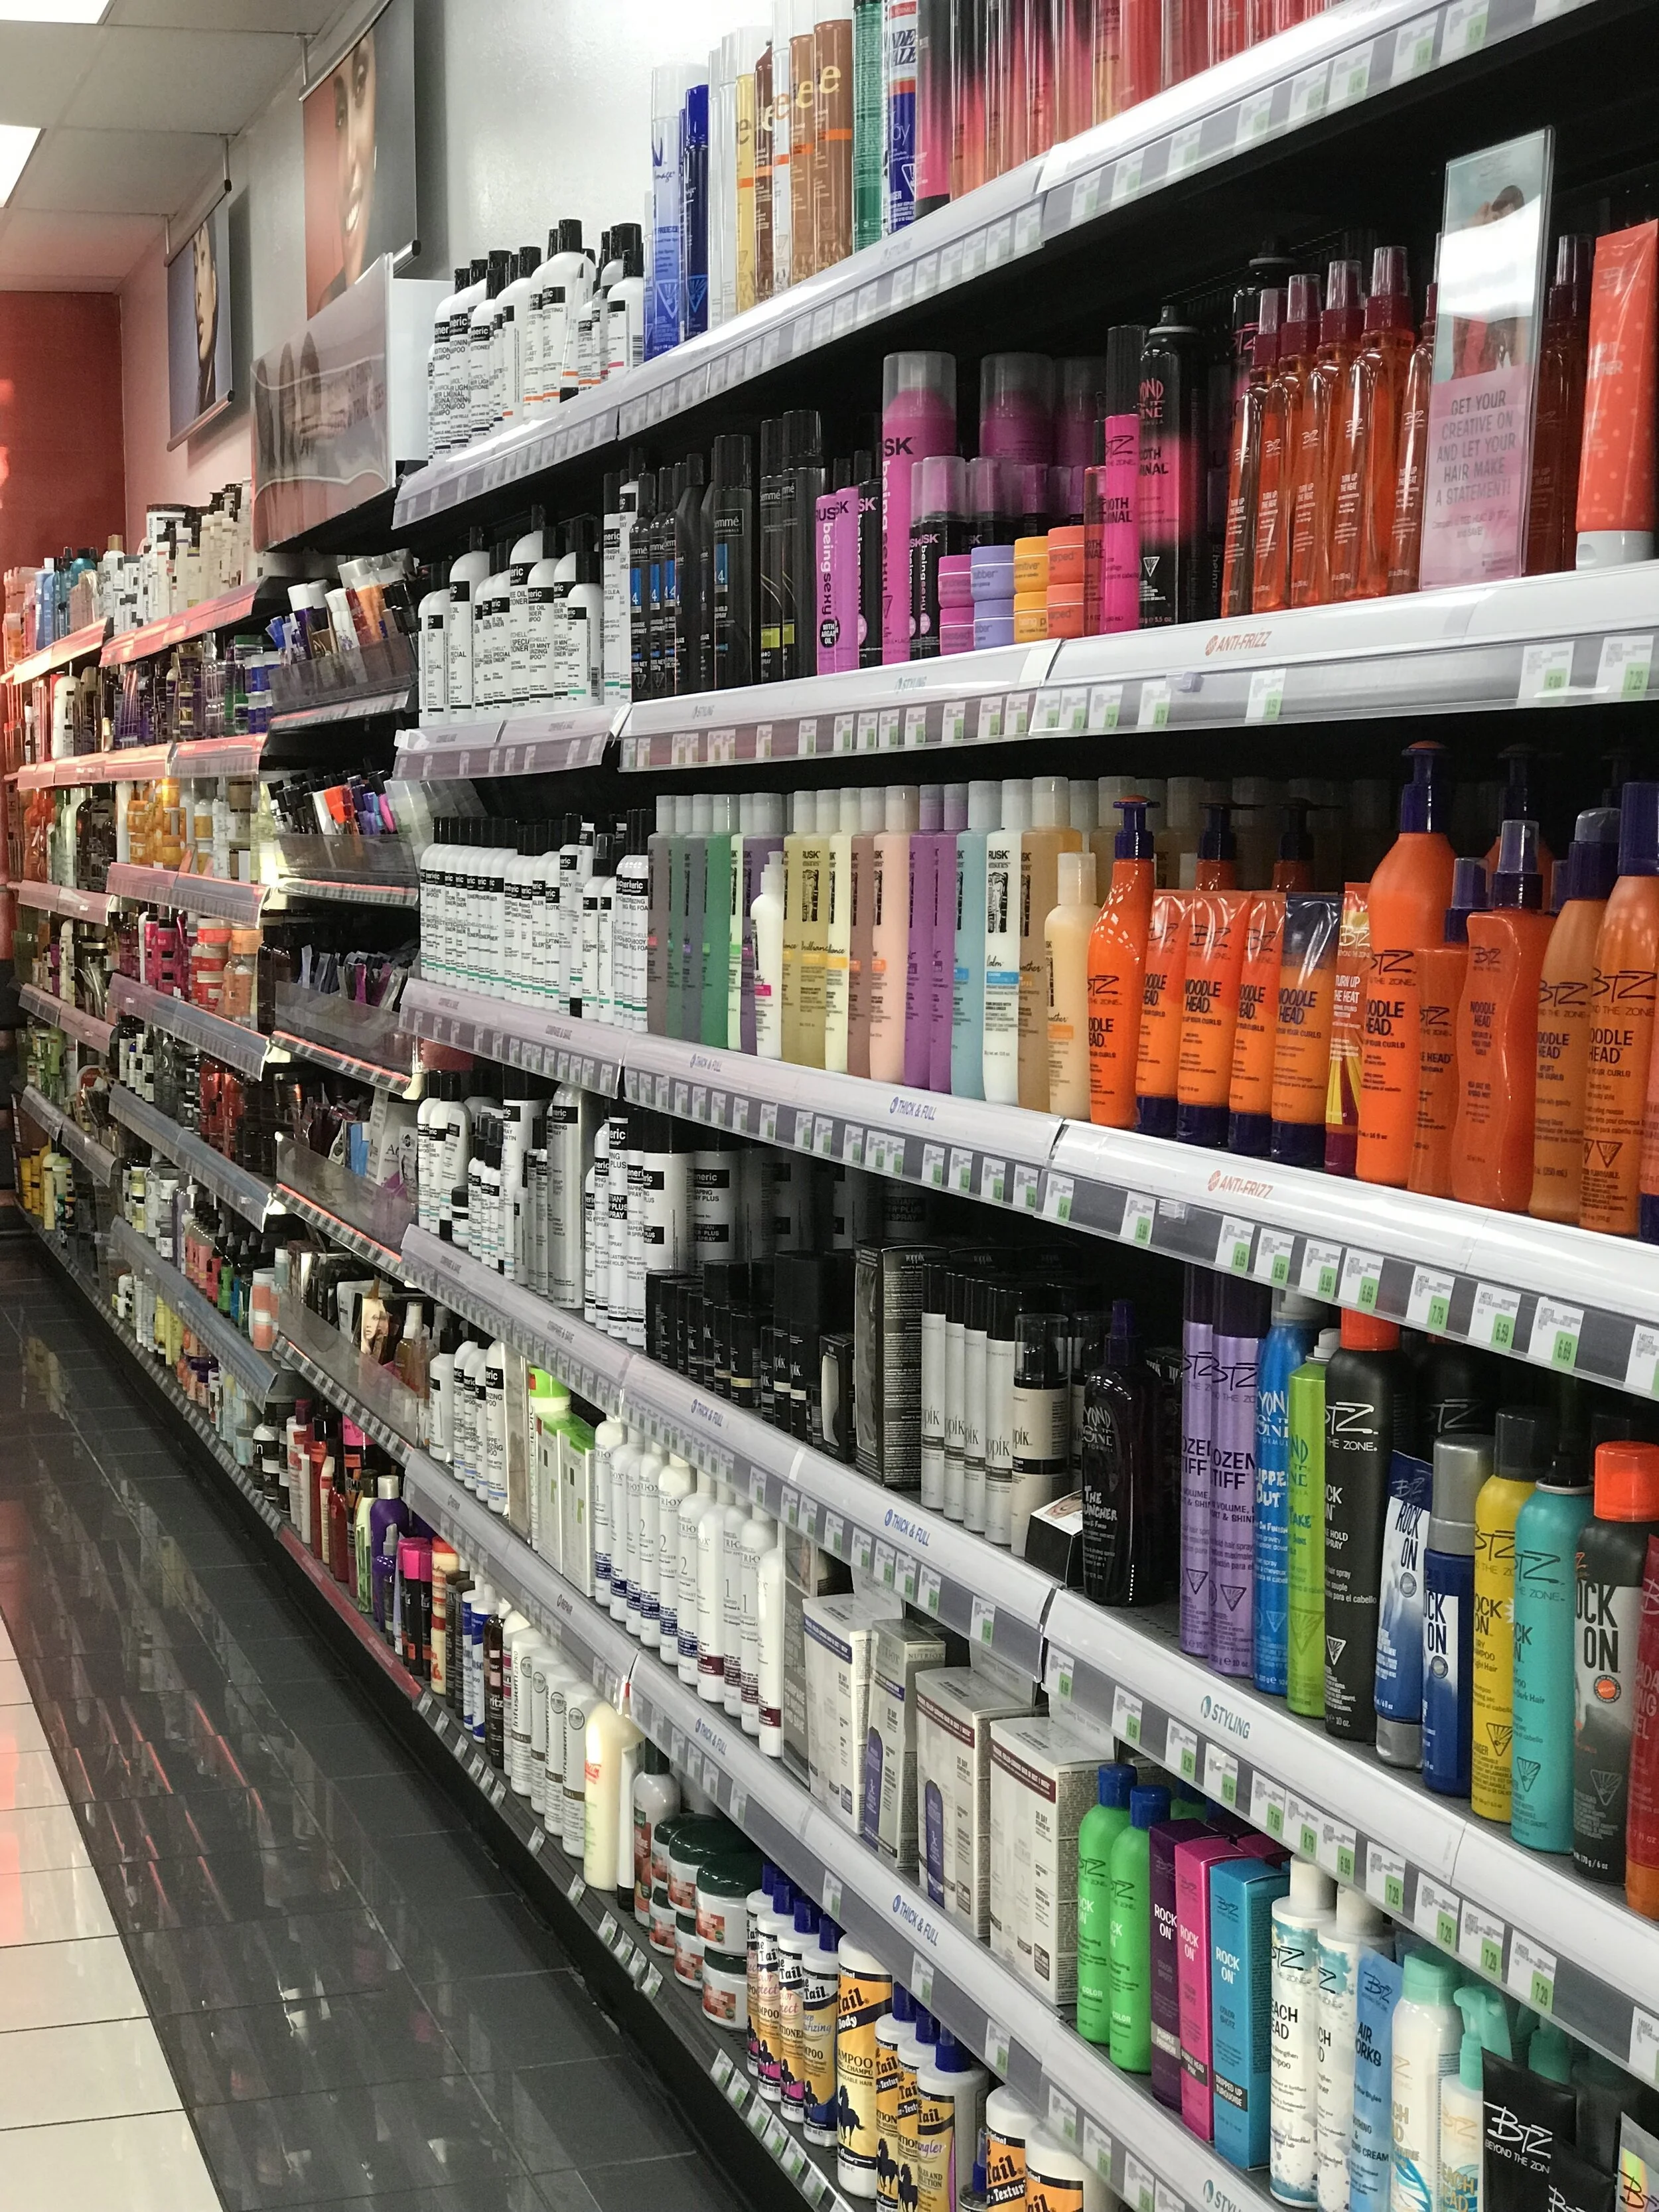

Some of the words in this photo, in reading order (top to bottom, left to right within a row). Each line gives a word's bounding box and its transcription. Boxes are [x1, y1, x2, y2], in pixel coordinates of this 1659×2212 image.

[1451, 397, 1471, 415] GET
[1476, 390, 1506, 411] YOUR
[1442, 415, 1492, 441] CREATIVE
[1497, 410, 1514, 429] ON
[884, 437, 913, 457] SK
[1437, 444, 1458, 463] AND
[1463, 439, 1480, 457] LET
[1484, 432, 1516, 454] YOUR
[1444, 465, 1469, 483] HAIR
[1474, 457, 1505, 477] MAKE
[1435, 489, 1442, 506] A
[1446, 479, 1510, 505] STATEMENT!
[718, 569, 725, 583] 4
[1216, 630, 1273, 656] ANTI-FRIZZ
[988, 850, 1008, 859] RUSK
[1350, 976, 1360, 988] UP
[1185, 996, 1210, 1013] HEAD
[1343, 992, 1360, 1003] HEAT
[1279, 1006, 1305, 1025] HEAD
[1603, 1005, 1620, 1015] THE
[1474, 1015, 1491, 1028] HEAD
[1427, 1053, 1451, 1064] HEAD
[897, 1100, 916, 1116] THICK
[914, 1104, 922, 1117] &
[920, 1105, 936, 1120] FULL
[610, 1128, 626, 1140] eric
[697, 1173, 717, 1181] neric
[1219, 1175, 1273, 1199] ANTI-FRIZZ
[1343, 1441, 1374, 1451] ZONE
[892, 1514, 910, 1534] THICK
[908, 1524, 916, 1538] &
[915, 1527, 930, 1546] FULL
[1395, 1503, 1423, 1539] ROCK
[1330, 1530, 1348, 1541] HOLD
[1400, 1537, 1419, 1572] ON
[681, 1556, 687, 1575] 2
[1353, 1595, 1378, 1604] cabello
[1530, 1588, 1559, 1601] ZONE
[1575, 1578, 1618, 1628] OCK
[1475, 1595, 1504, 1619] OCK
[1427, 1622, 1447, 1655] ON
[1584, 1625, 1619, 1674] ON
[1211, 1703, 1251, 1739] STYLING
[900, 1901, 918, 1927] THICK
[917, 1918, 924, 1933] &
[923, 1923, 938, 1946] FULL
[1154, 1903, 1177, 1928] ROCK
[1160, 1923, 1172, 1941] ON
[1180, 1924, 1200, 1949] ROCK
[1441, 1922, 1452, 1945] 7.29
[1185, 1943, 1194, 1962] ON
[1216, 1946, 1240, 1972] ROCK
[1485, 1949, 1497, 1972] 7.29
[1221, 1966, 1234, 1984] ON
[805, 1986, 826, 2000] Tail
[1536, 1982, 1548, 2006] 7.29
[1358, 2022, 1372, 2043] AIR
[838, 2048, 873, 2069] AMPOO
[1355, 2038, 1382, 2068] ORKS
[1235, 2087, 1242, 2097] UP
[1483, 2101, 1553, 2159] BTZ
[1362, 2147, 1390, 2162] CREAM
[1484, 2139, 1512, 2159] BEYOND
[1514, 2152, 1528, 2167] THE
[1530, 2160, 1550, 2175] ZON
